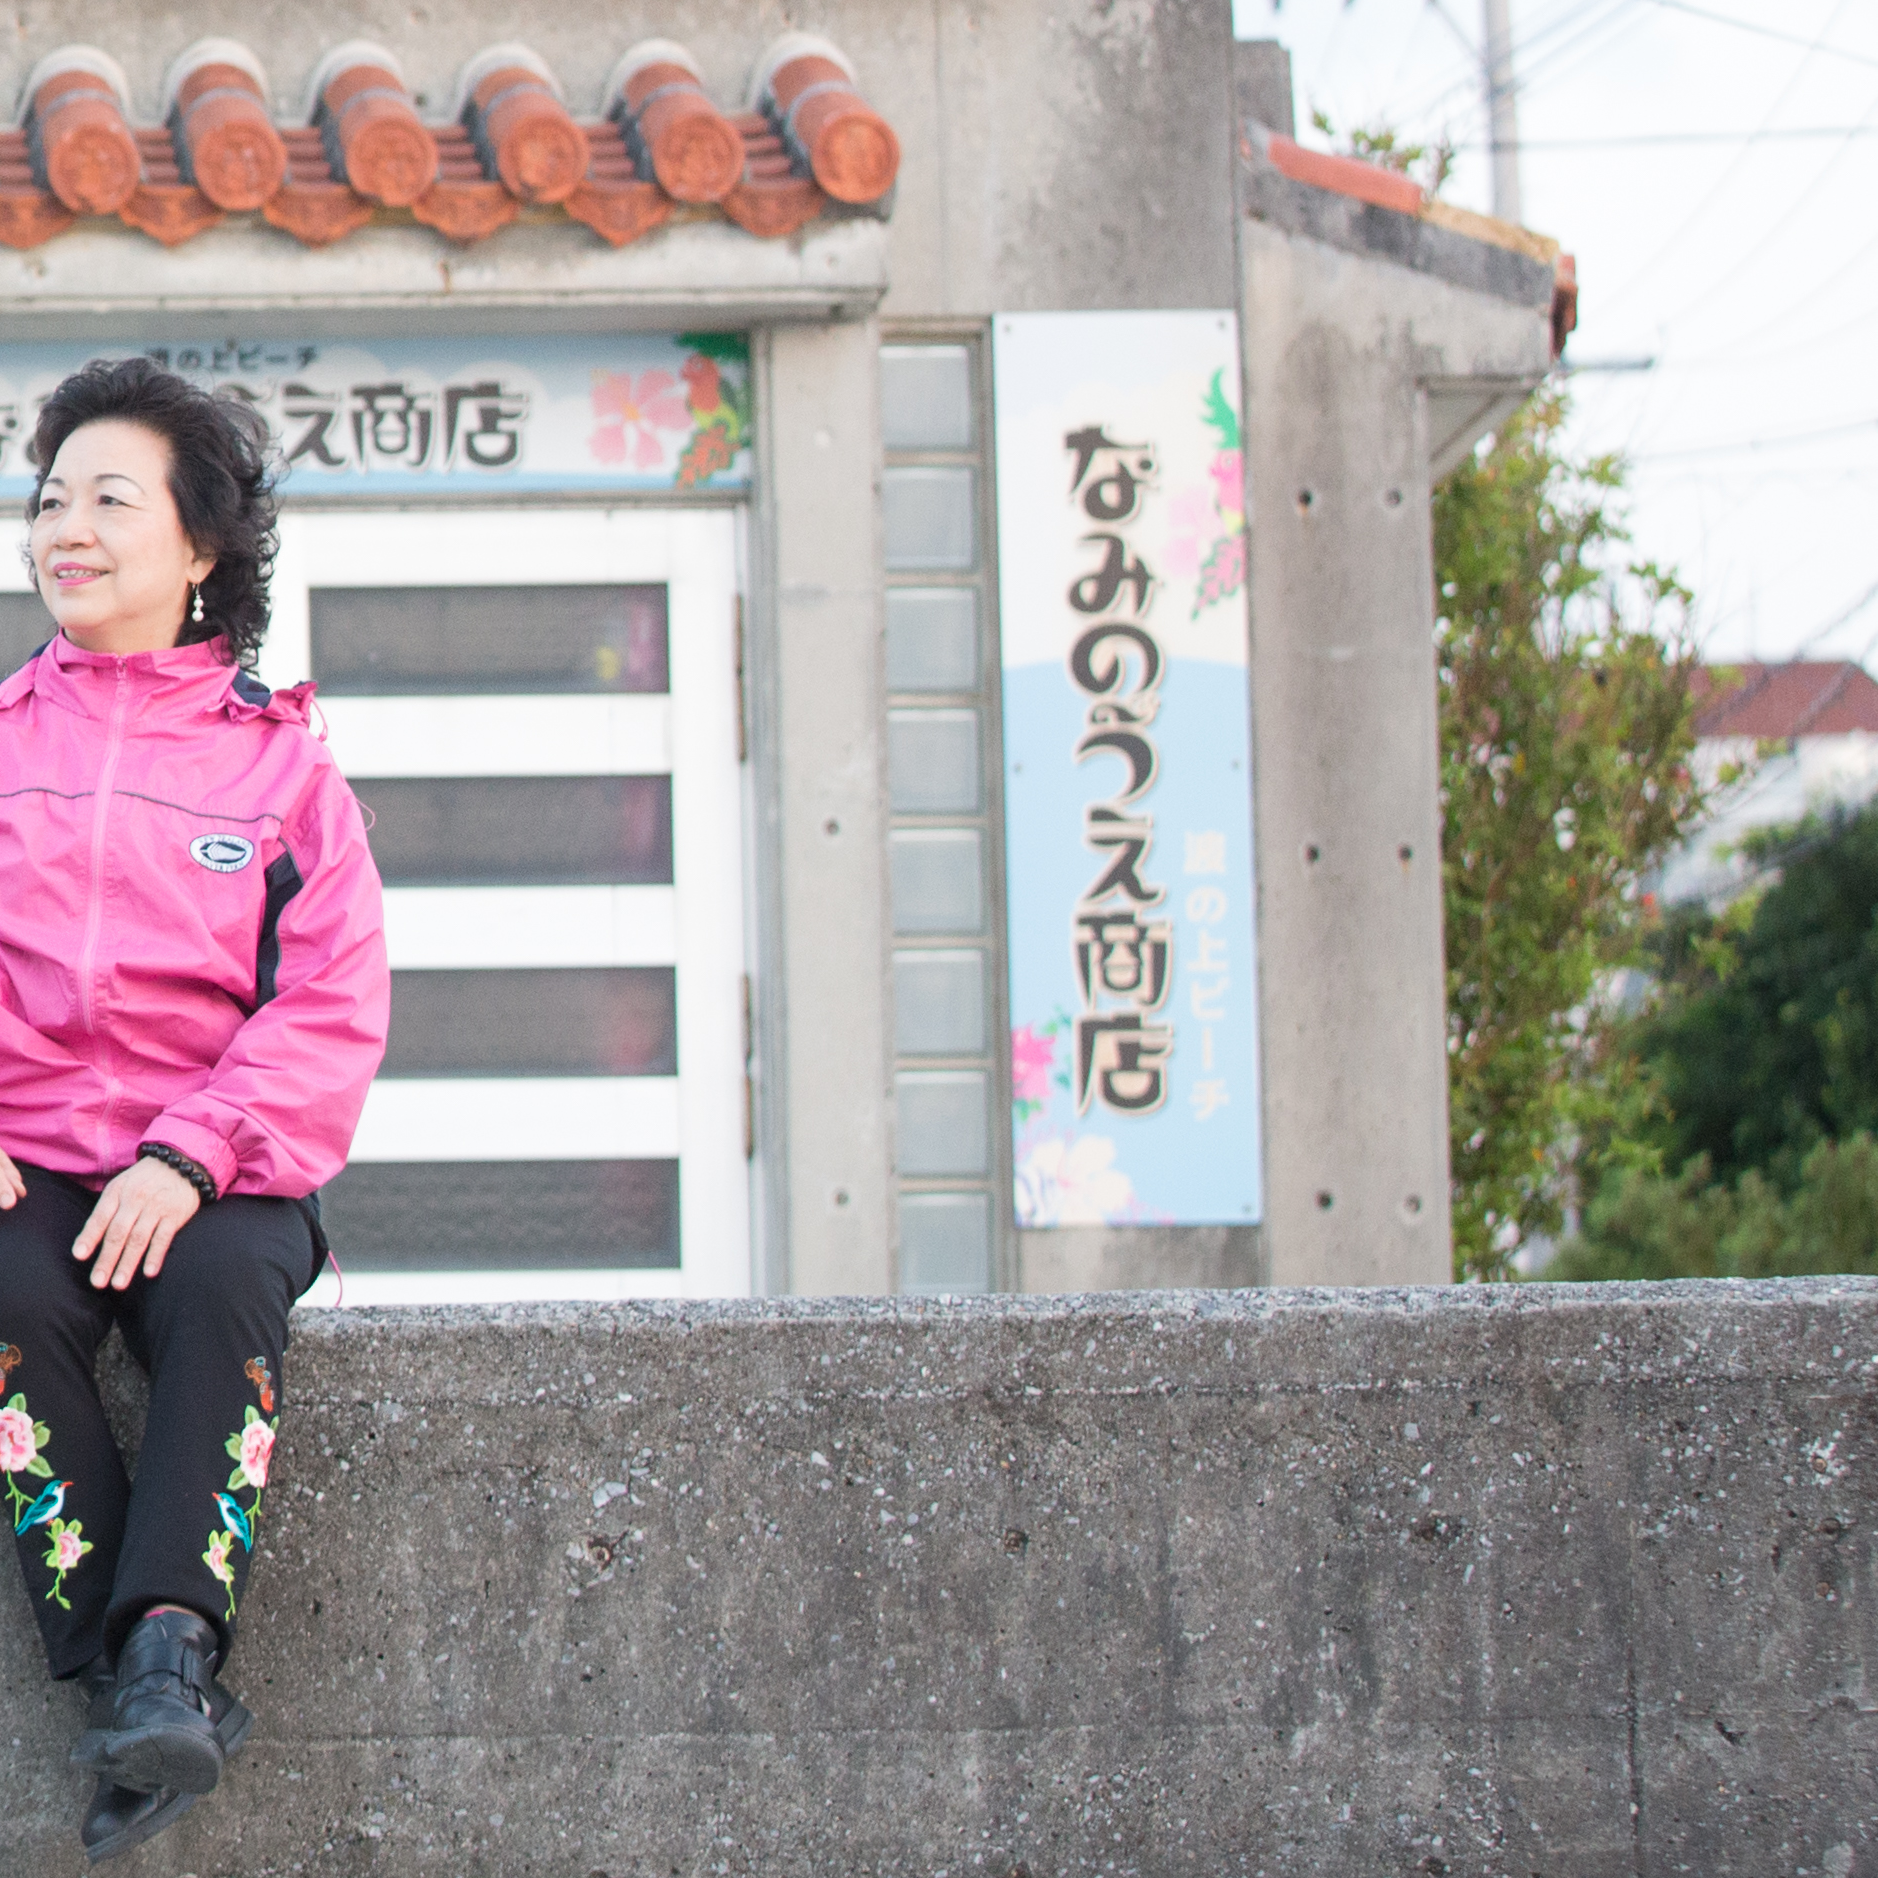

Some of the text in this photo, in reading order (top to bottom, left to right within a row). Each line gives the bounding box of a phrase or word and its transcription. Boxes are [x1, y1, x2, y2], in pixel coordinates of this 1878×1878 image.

[1065, 423, 1171, 1117] なみのうえ商店
